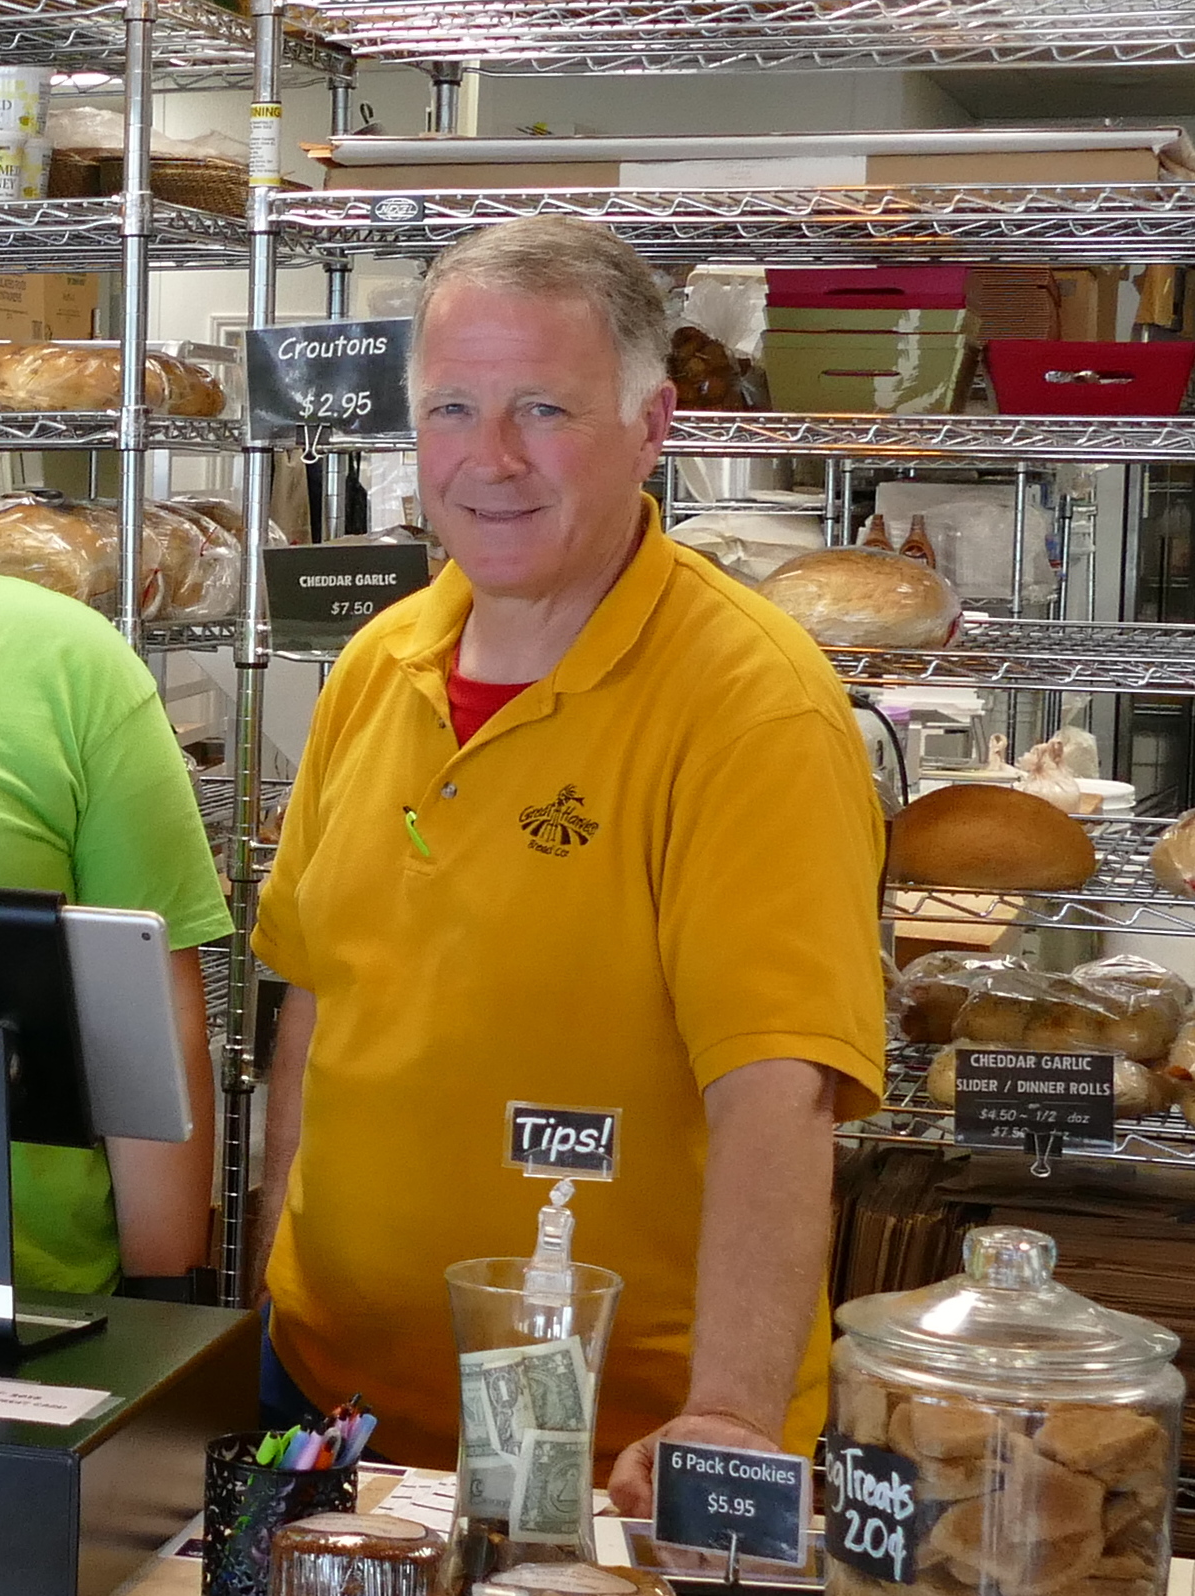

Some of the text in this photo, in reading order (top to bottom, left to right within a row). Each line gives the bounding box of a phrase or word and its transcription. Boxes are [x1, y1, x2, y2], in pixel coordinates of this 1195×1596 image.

[278, 337, 387, 360] Croutons
[299, 388, 372, 419] $2.95
[299, 573, 397, 587] CHEDDAR GARLIC
[331, 602, 373, 615] $7.50
[970, 1054, 1092, 1070] CHEDDAR GARLIC
[956, 1078, 998, 1092] SLIDER
[1017, 1080, 1065, 1094] DINNER
[1070, 1082, 1110, 1096] ROLLS
[979, 1108, 1017, 1121] $4.50
[1035, 1110, 1058, 1122] 1/2
[1067, 1112, 1091, 1124] doz
[515, 1116, 612, 1161] Tips!
[671, 1451, 795, 1484] 6 Pack Cookies
[840, 1448, 914, 1520] Treats
[707, 1491, 755, 1518] $5.95
